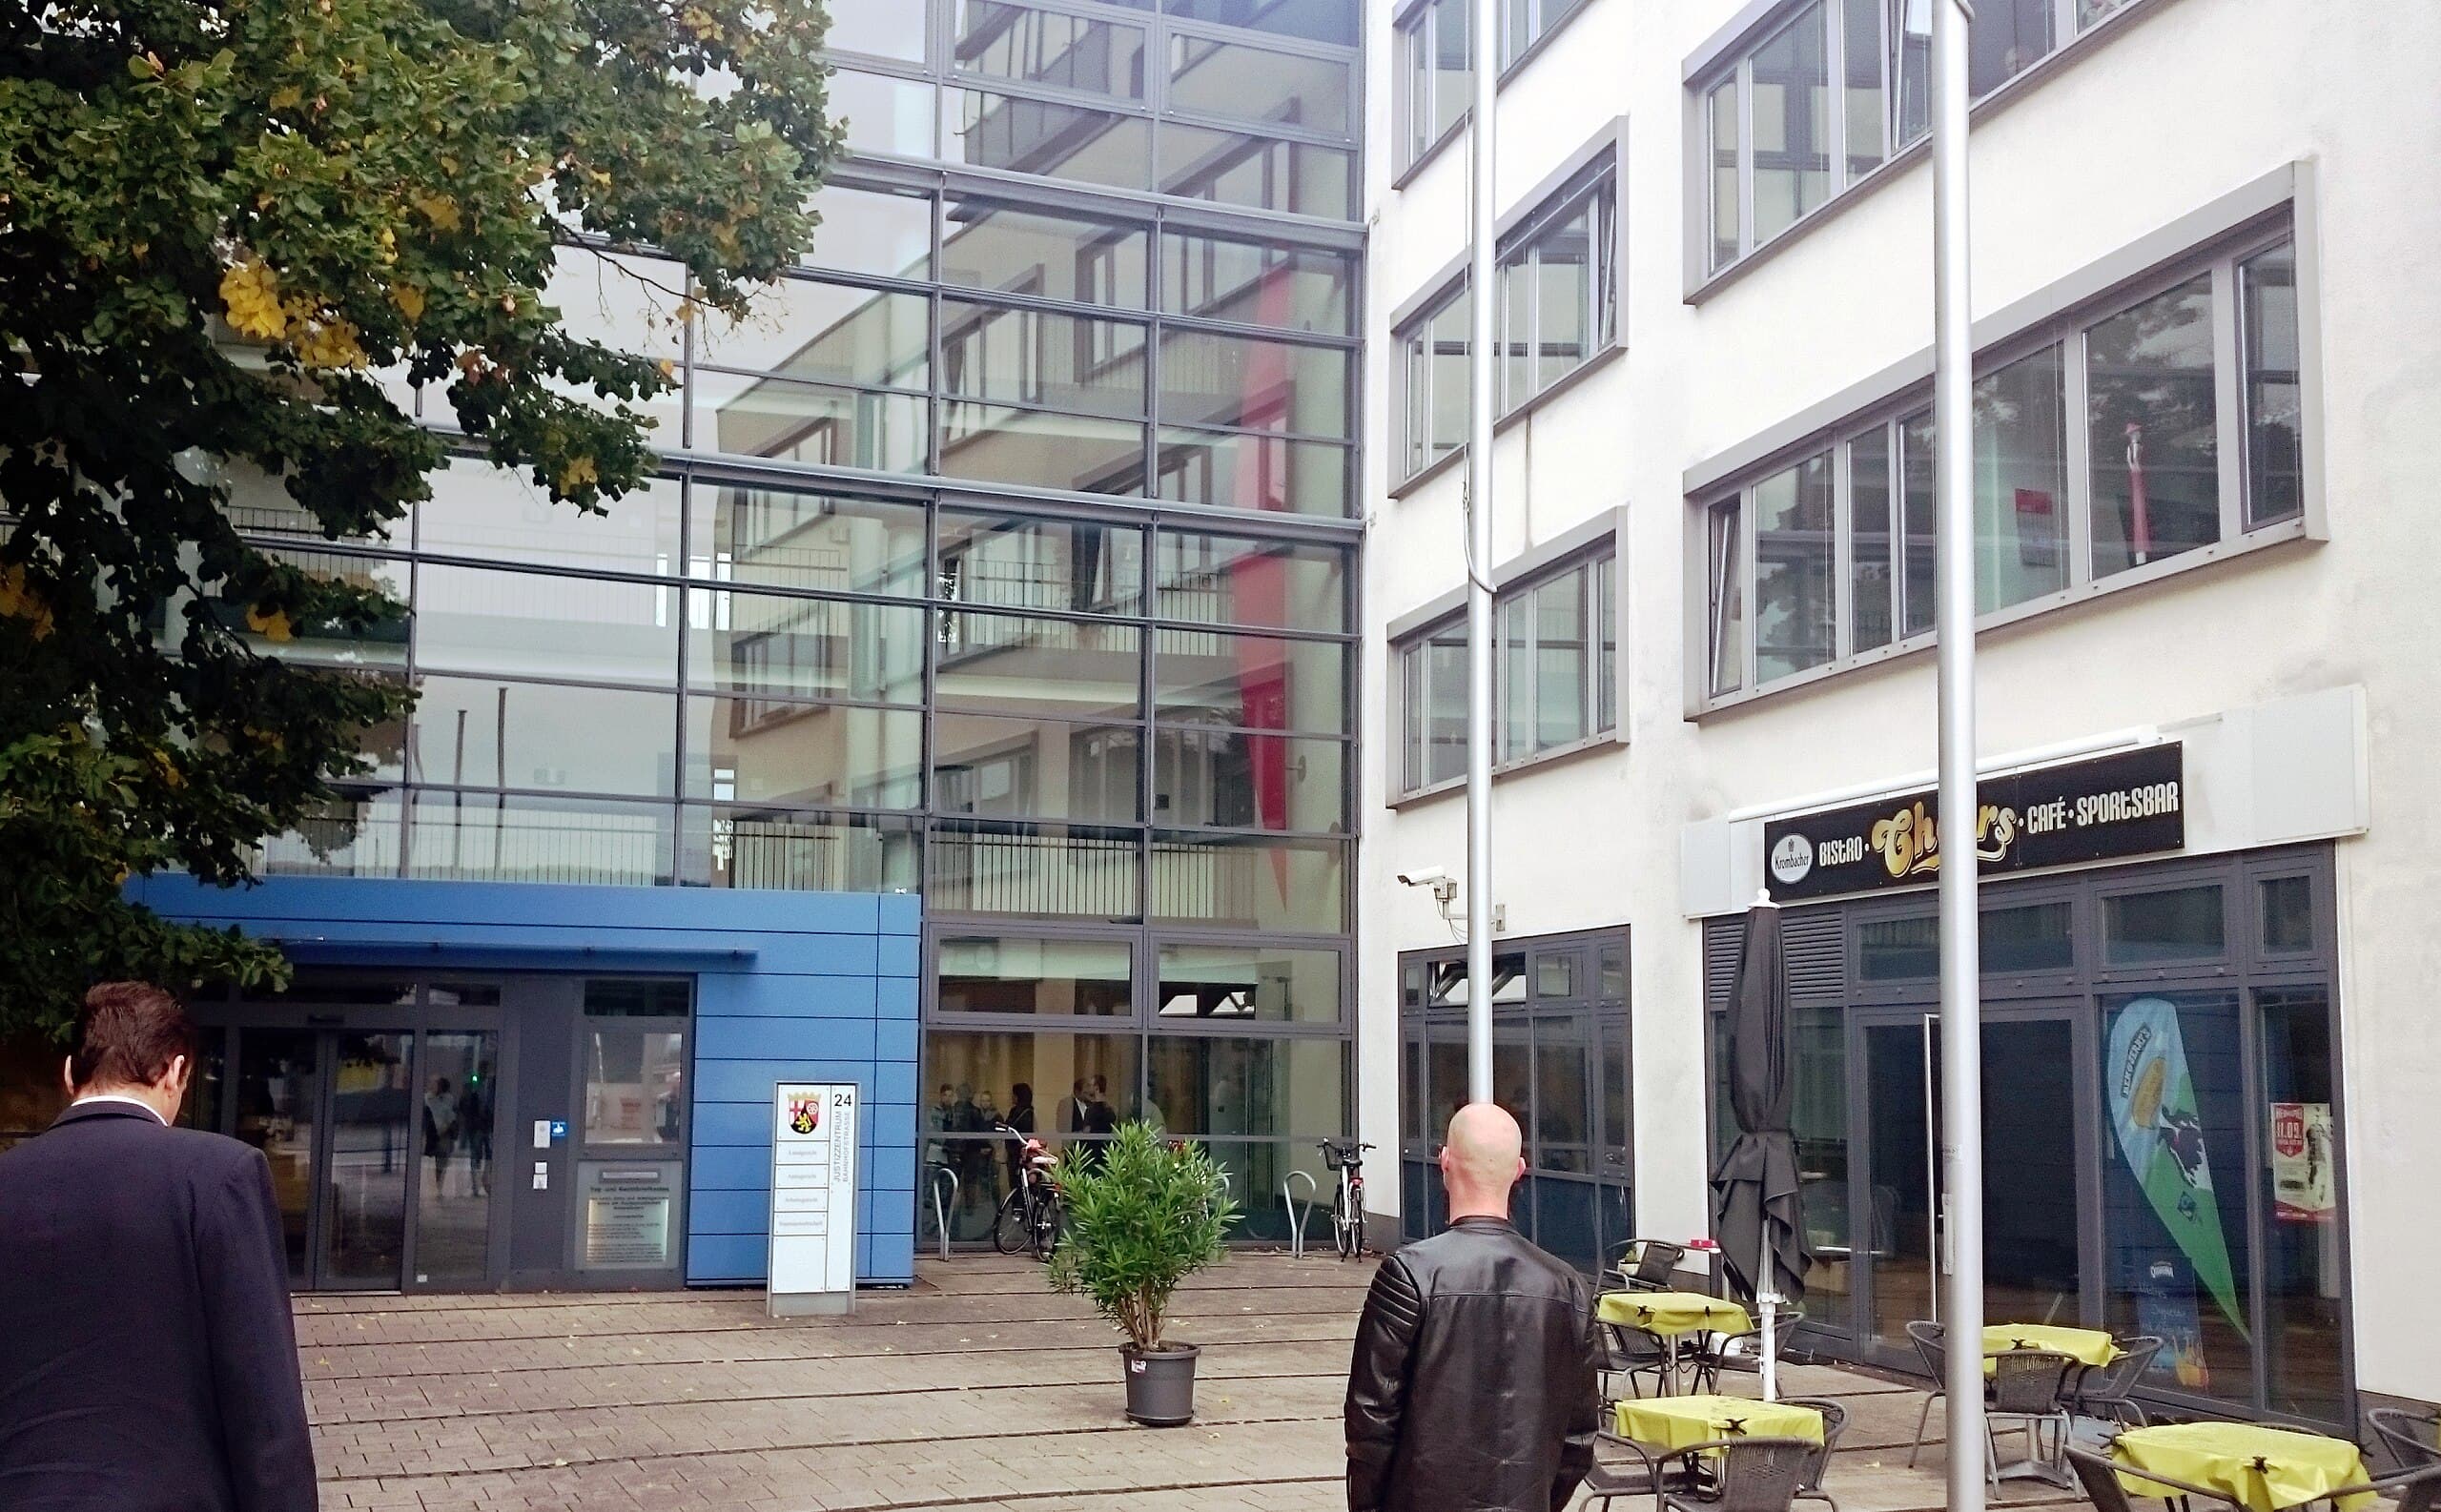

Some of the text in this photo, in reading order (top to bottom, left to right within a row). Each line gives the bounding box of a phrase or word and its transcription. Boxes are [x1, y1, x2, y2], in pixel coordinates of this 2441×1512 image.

[1872, 801, 2017, 878] Chrs
[2027, 796, 2066, 834] CAFÉ
[1774, 851, 1809, 869] Krombacher
[834, 1093, 852, 1107] 24
[833, 1110, 842, 1182] JUSTIZZENTRUM
